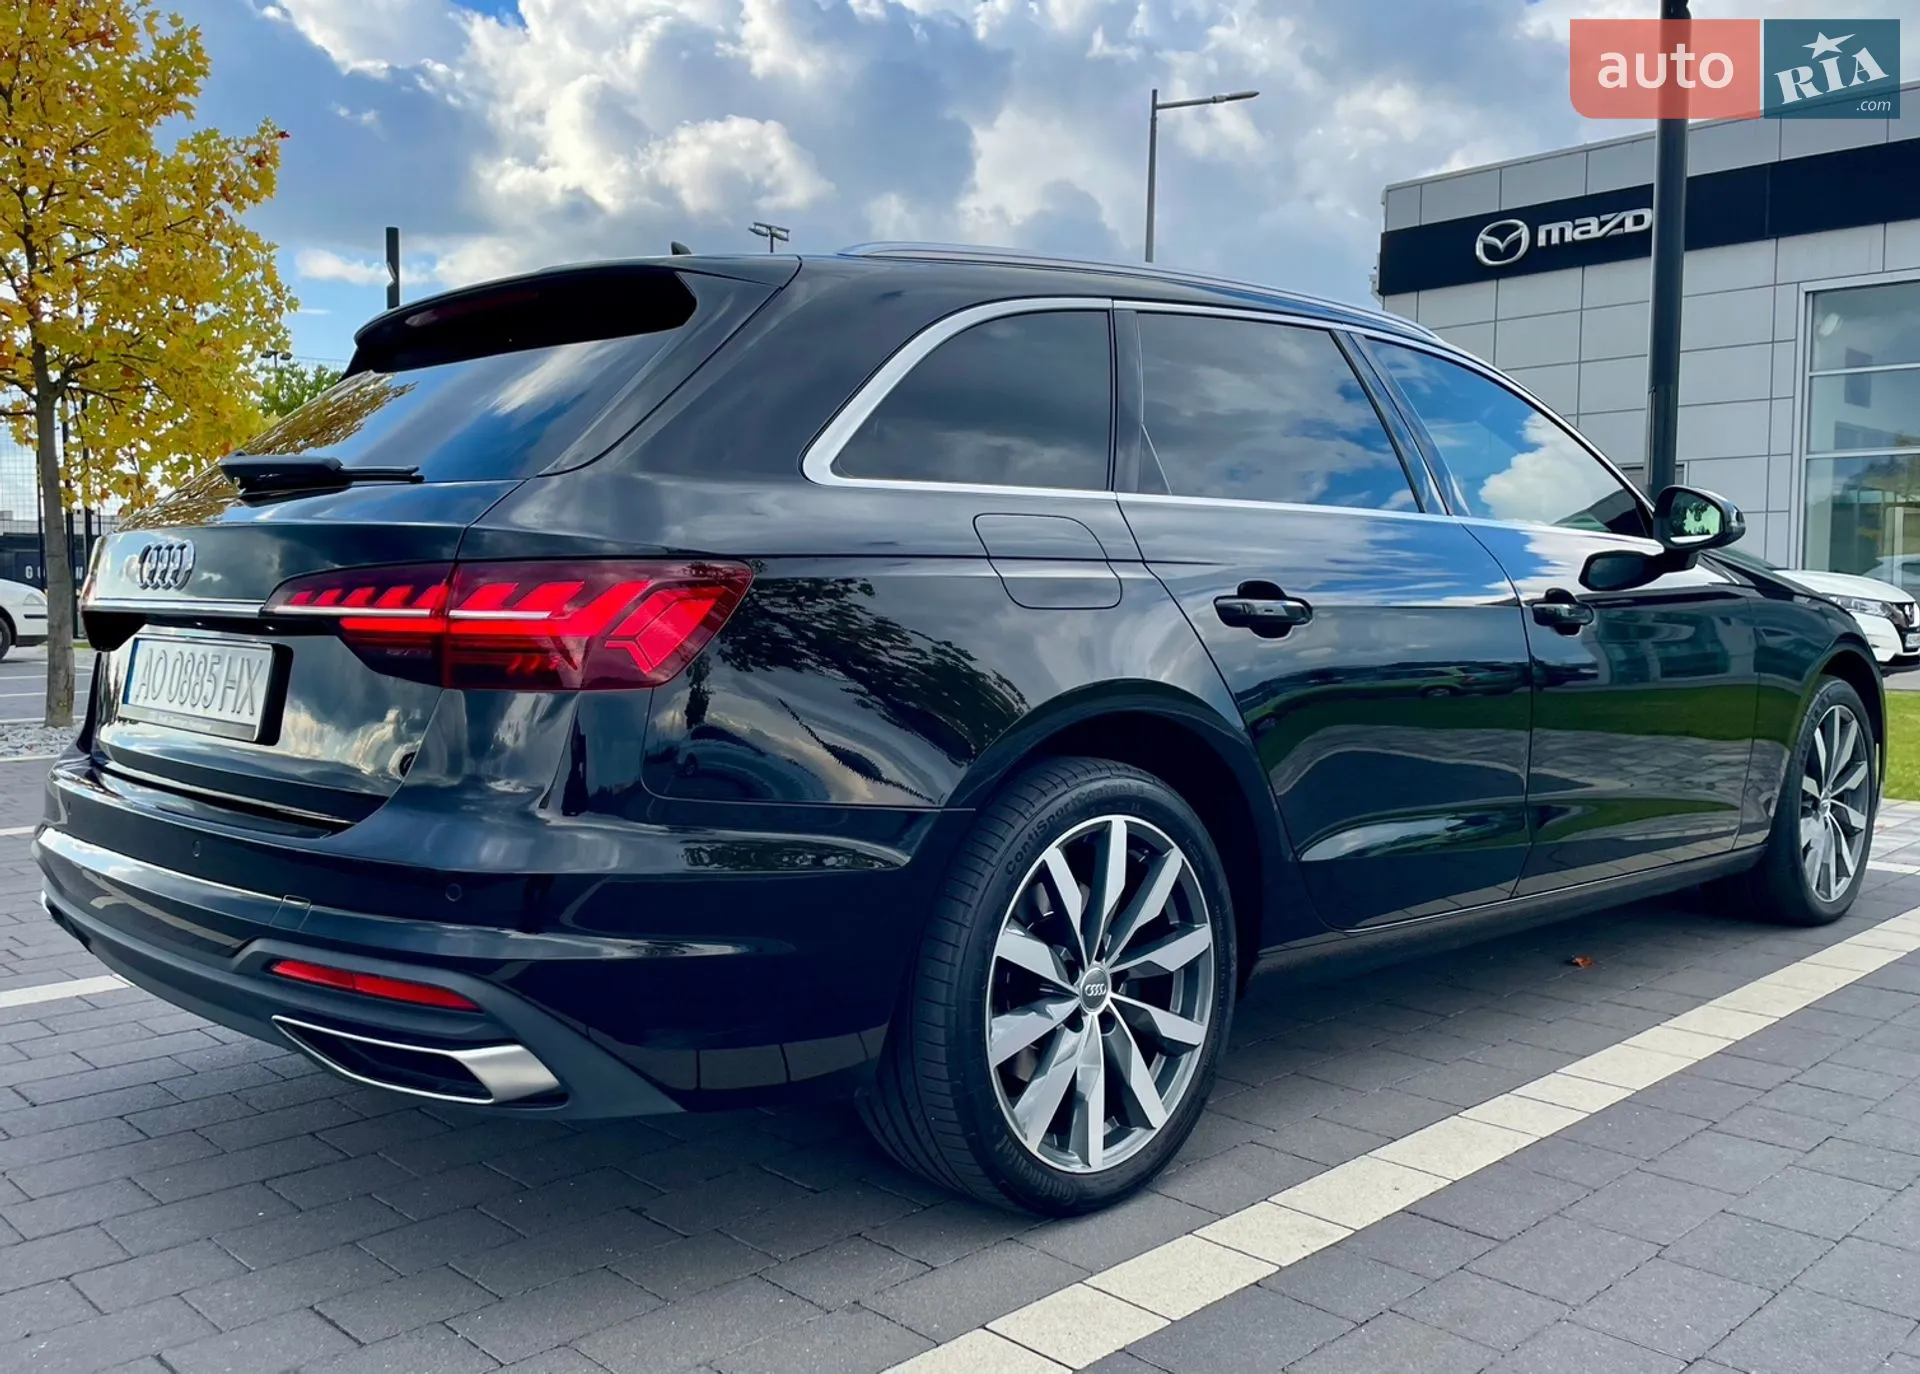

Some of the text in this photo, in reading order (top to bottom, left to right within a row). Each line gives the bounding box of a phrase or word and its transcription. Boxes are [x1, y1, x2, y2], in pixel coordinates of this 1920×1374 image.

[135, 648, 263, 716] AO 0885 HX
